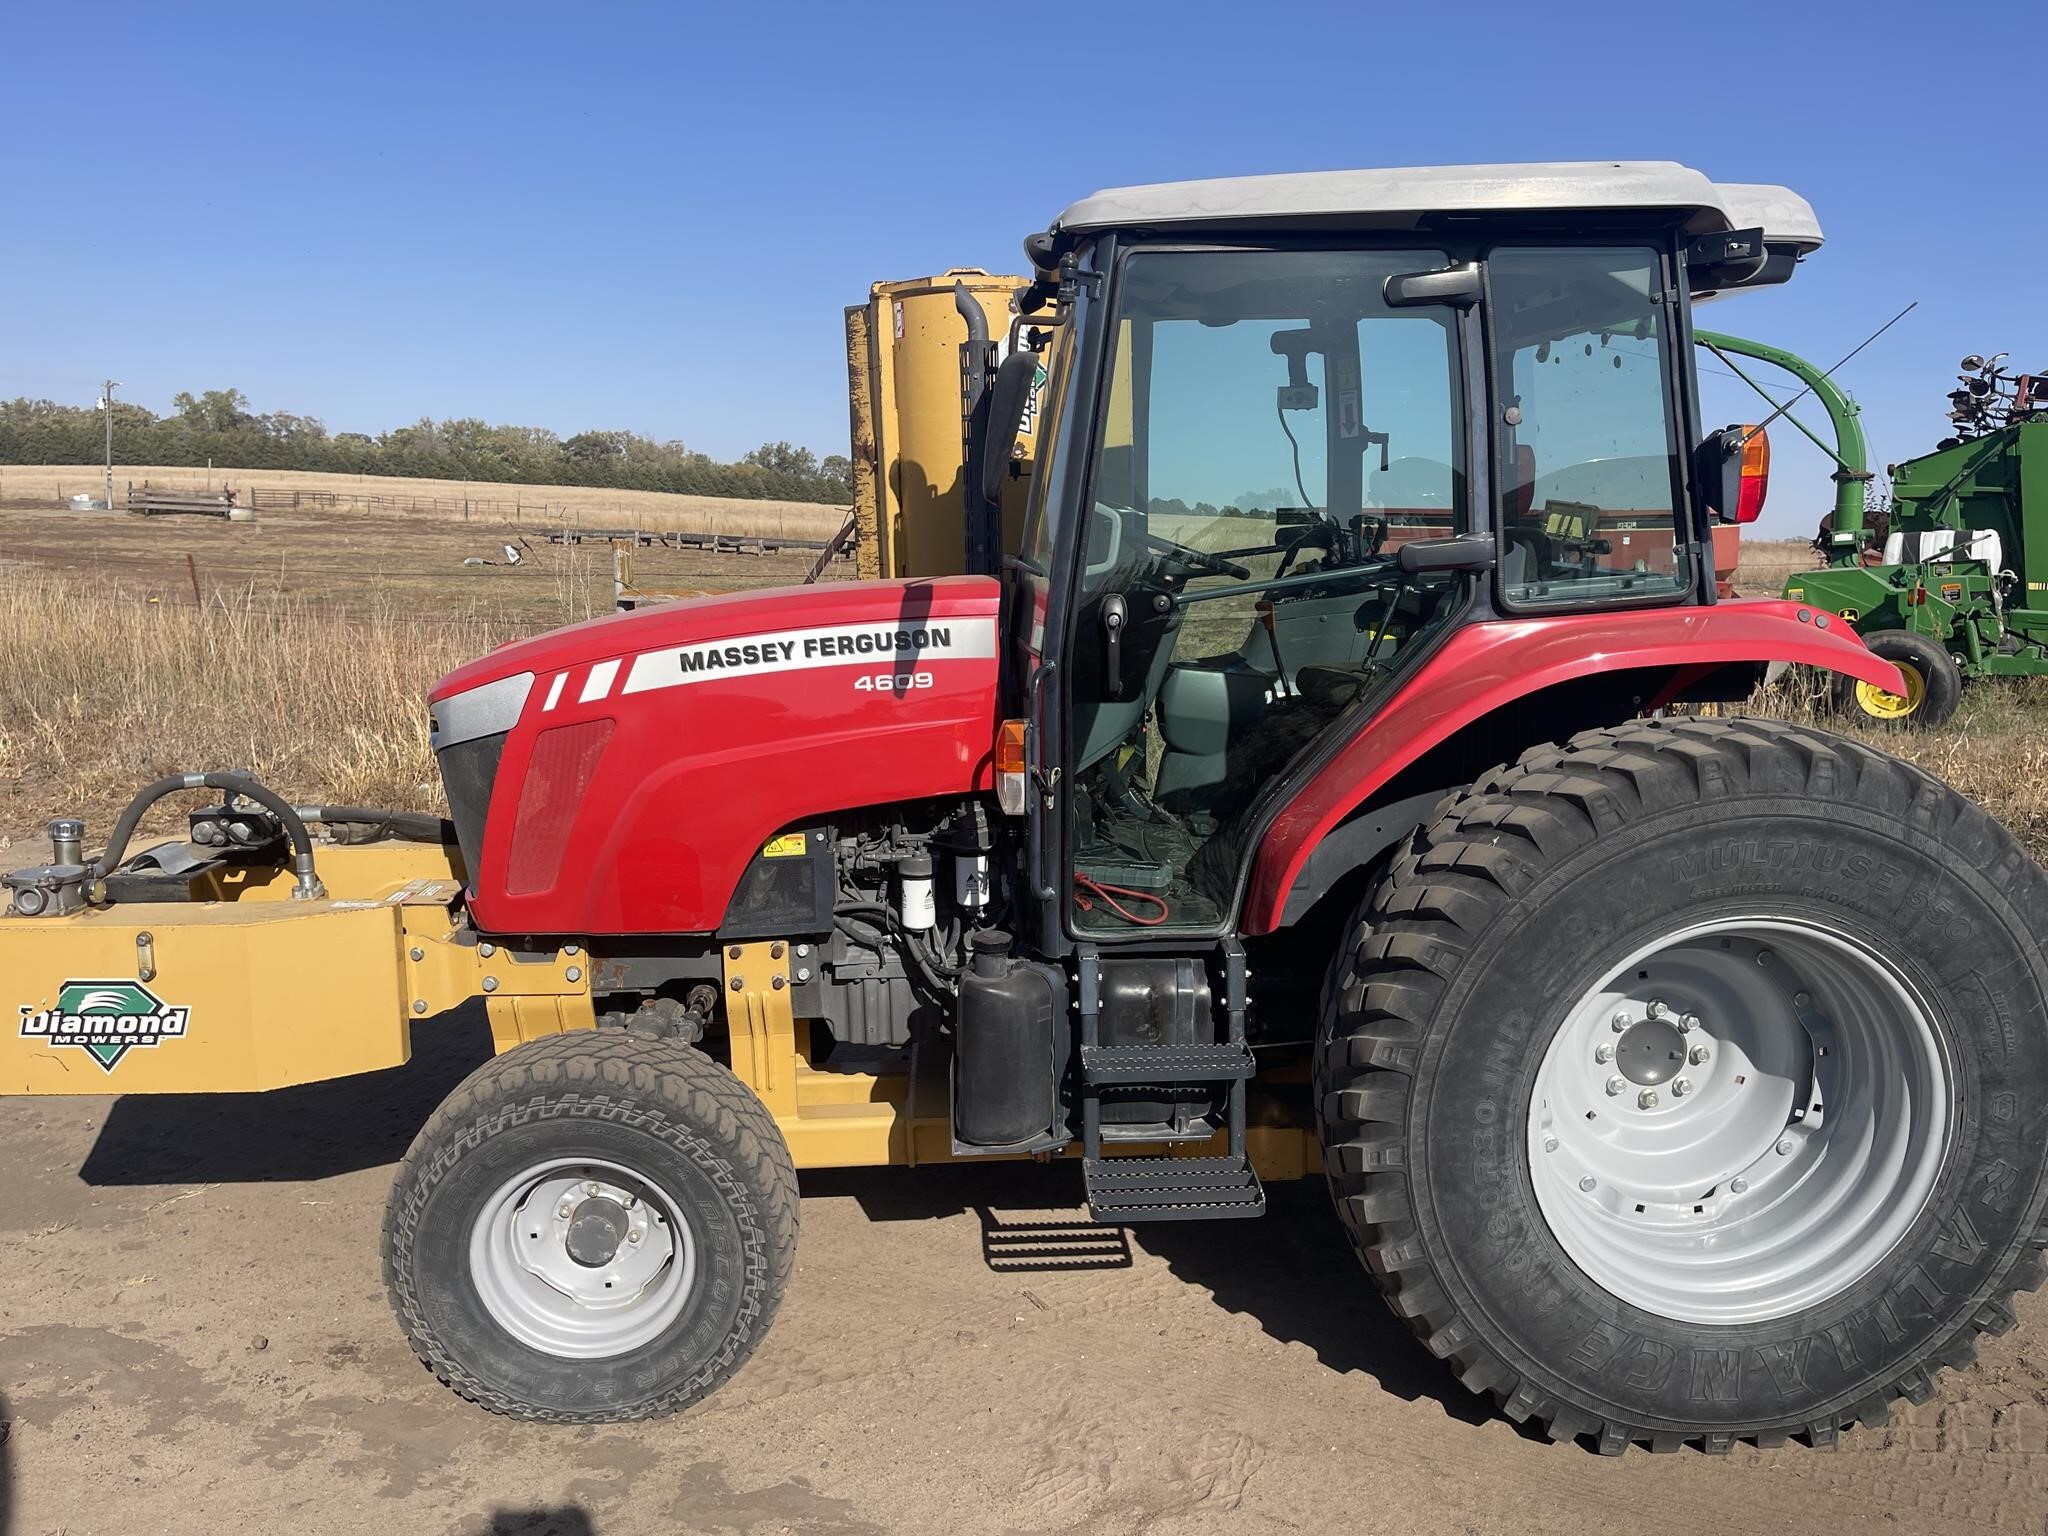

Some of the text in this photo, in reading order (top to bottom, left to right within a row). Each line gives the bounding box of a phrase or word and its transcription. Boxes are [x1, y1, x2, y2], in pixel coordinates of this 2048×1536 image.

[679, 627, 951, 673] MASSEY FERGUSON
[854, 672, 934, 692] 4609
[1670, 839, 1900, 896] MULTIUSE
[1904, 885, 1973, 942] 550
[24, 1010, 183, 1033] Diamond
[54, 1035, 156, 1044] MOWERS
[422, 1135, 536, 1258] COOPER
[541, 1200, 731, 1400] DISCOVERER S/T
[1568, 1204, 1989, 1400] ALLIANCE
